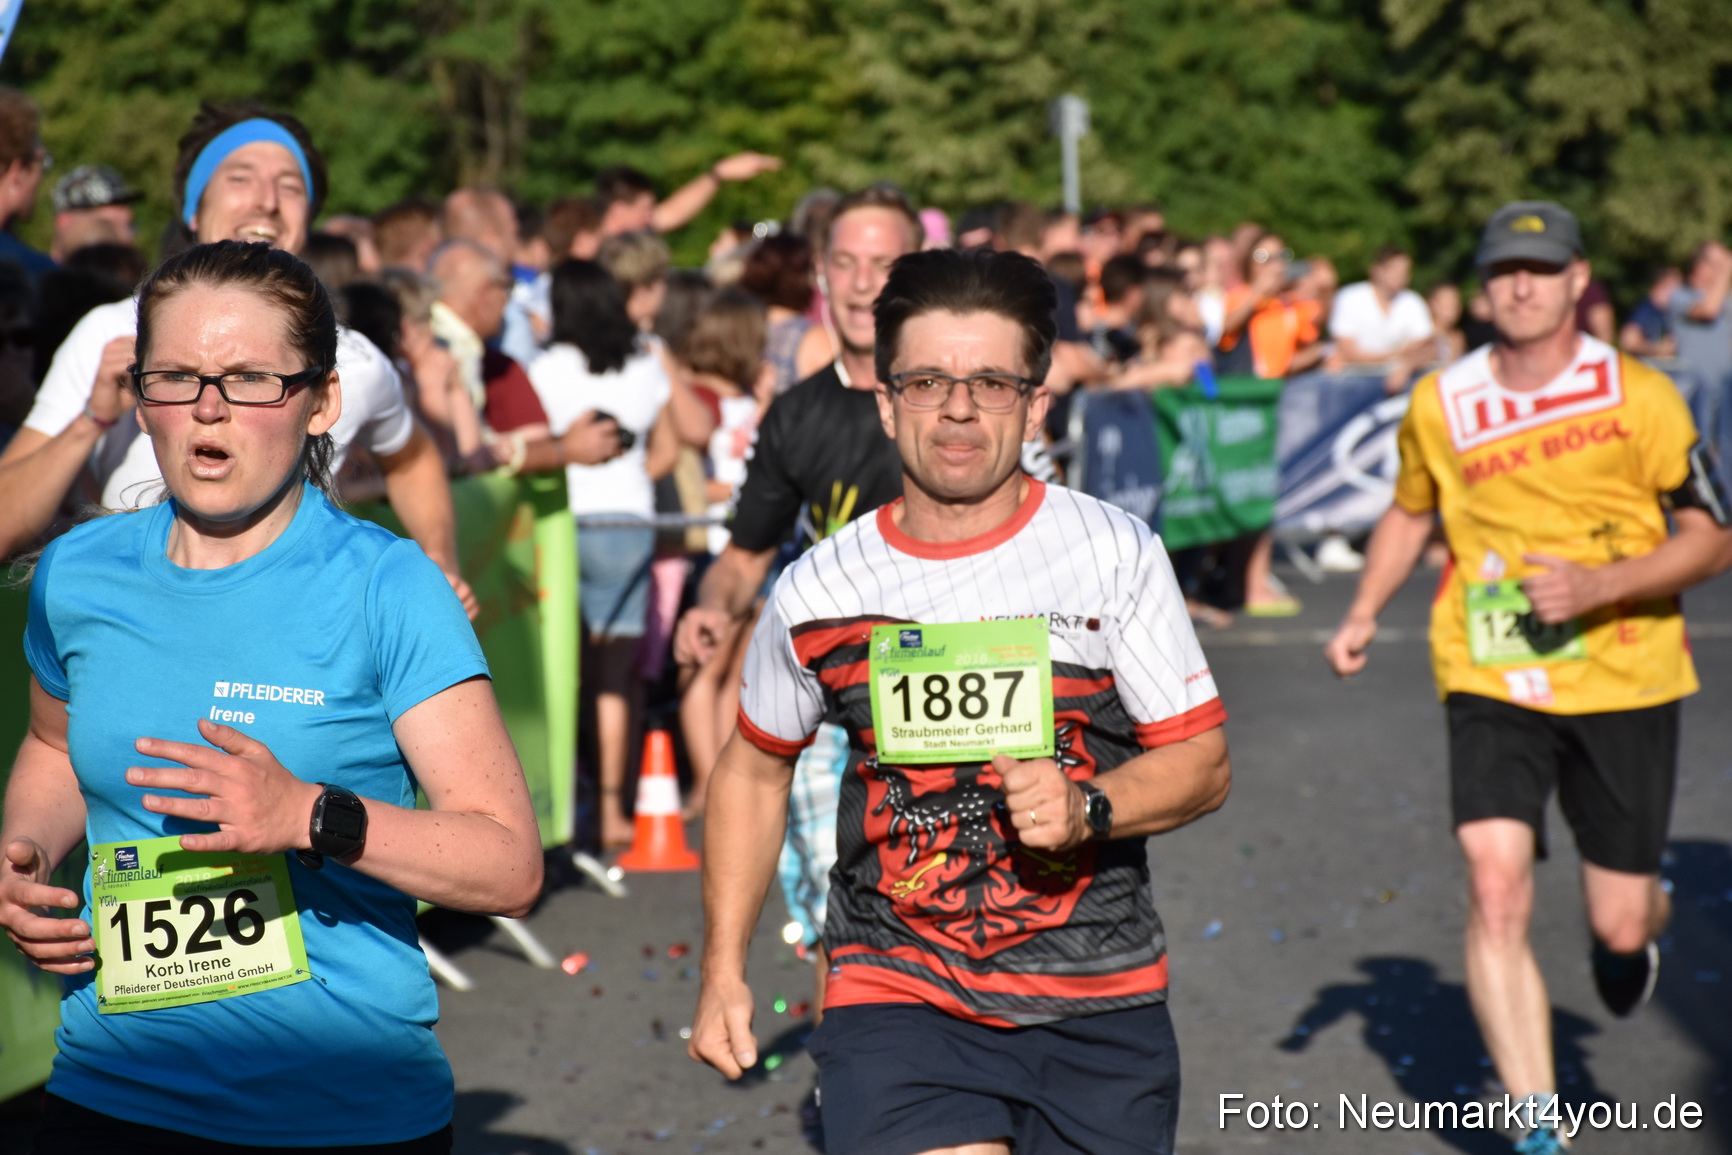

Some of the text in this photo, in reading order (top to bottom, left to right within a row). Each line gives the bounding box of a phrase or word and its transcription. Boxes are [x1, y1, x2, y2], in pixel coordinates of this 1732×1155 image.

[1462, 418, 1633, 487] MAX BÖGL
[955, 653, 989, 666] 2018
[231, 682, 325, 706] PFLEIDERER
[892, 670, 1025, 722] 1887
[209, 705, 255, 724] Irene
[892, 721, 1033, 739] Straubmeier Gerhard
[923, 738, 996, 749] Stadt Neumarkt
[107, 863, 164, 883] firmenlauf
[175, 872, 211, 888] 2018
[110, 888, 266, 962] 1526
[145, 957, 231, 979] Korb Irene
[114, 963, 274, 996] Pfleiderer Deutschland GmbH
